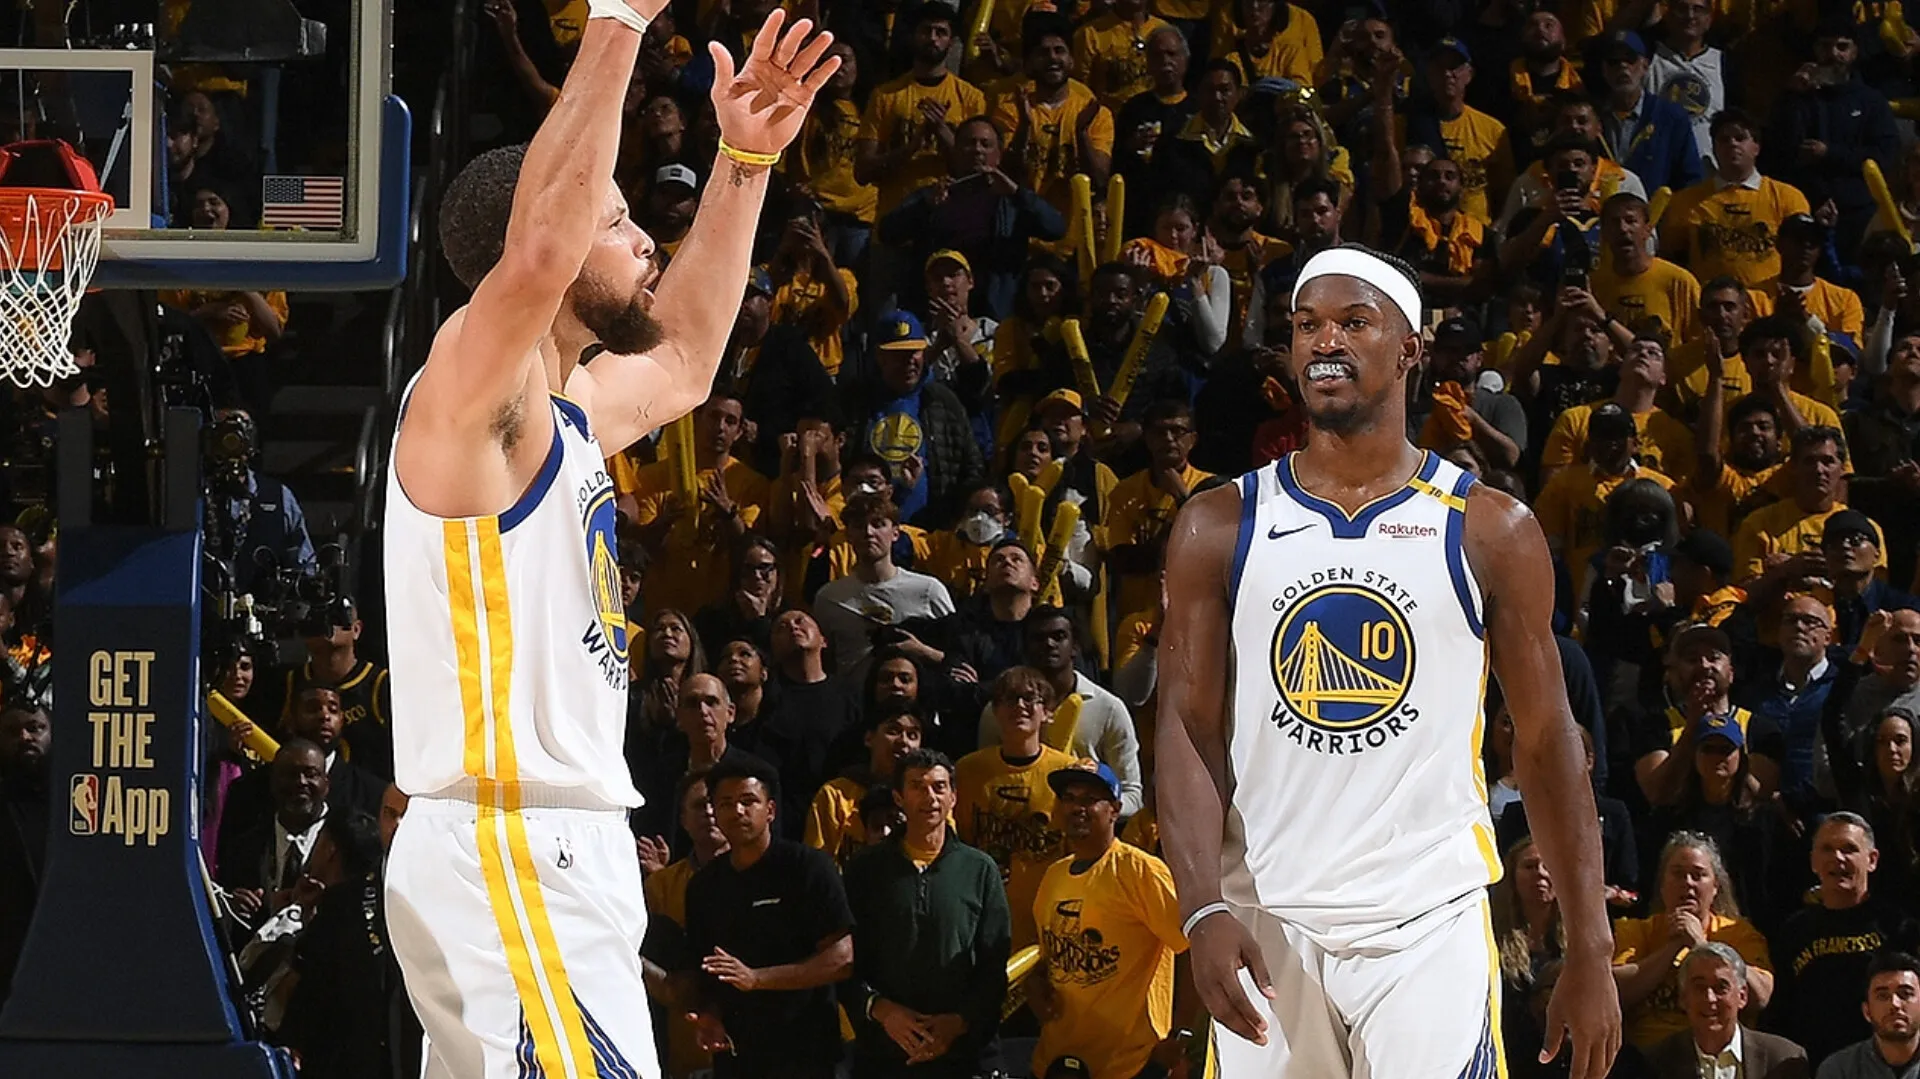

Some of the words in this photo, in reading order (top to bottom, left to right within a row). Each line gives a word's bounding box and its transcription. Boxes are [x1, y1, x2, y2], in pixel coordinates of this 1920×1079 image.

[1378, 522, 1438, 539] Rakuten
[1272, 567, 1354, 612] GOLDEN
[1363, 570, 1418, 613] STATE
[1361, 621, 1396, 661] 10
[89, 650, 156, 707] GET
[88, 712, 155, 768] THE
[1270, 702, 1420, 755] WARRIORS
[101, 775, 170, 846] App
[1812, 931, 1882, 957] FRANCISCO
